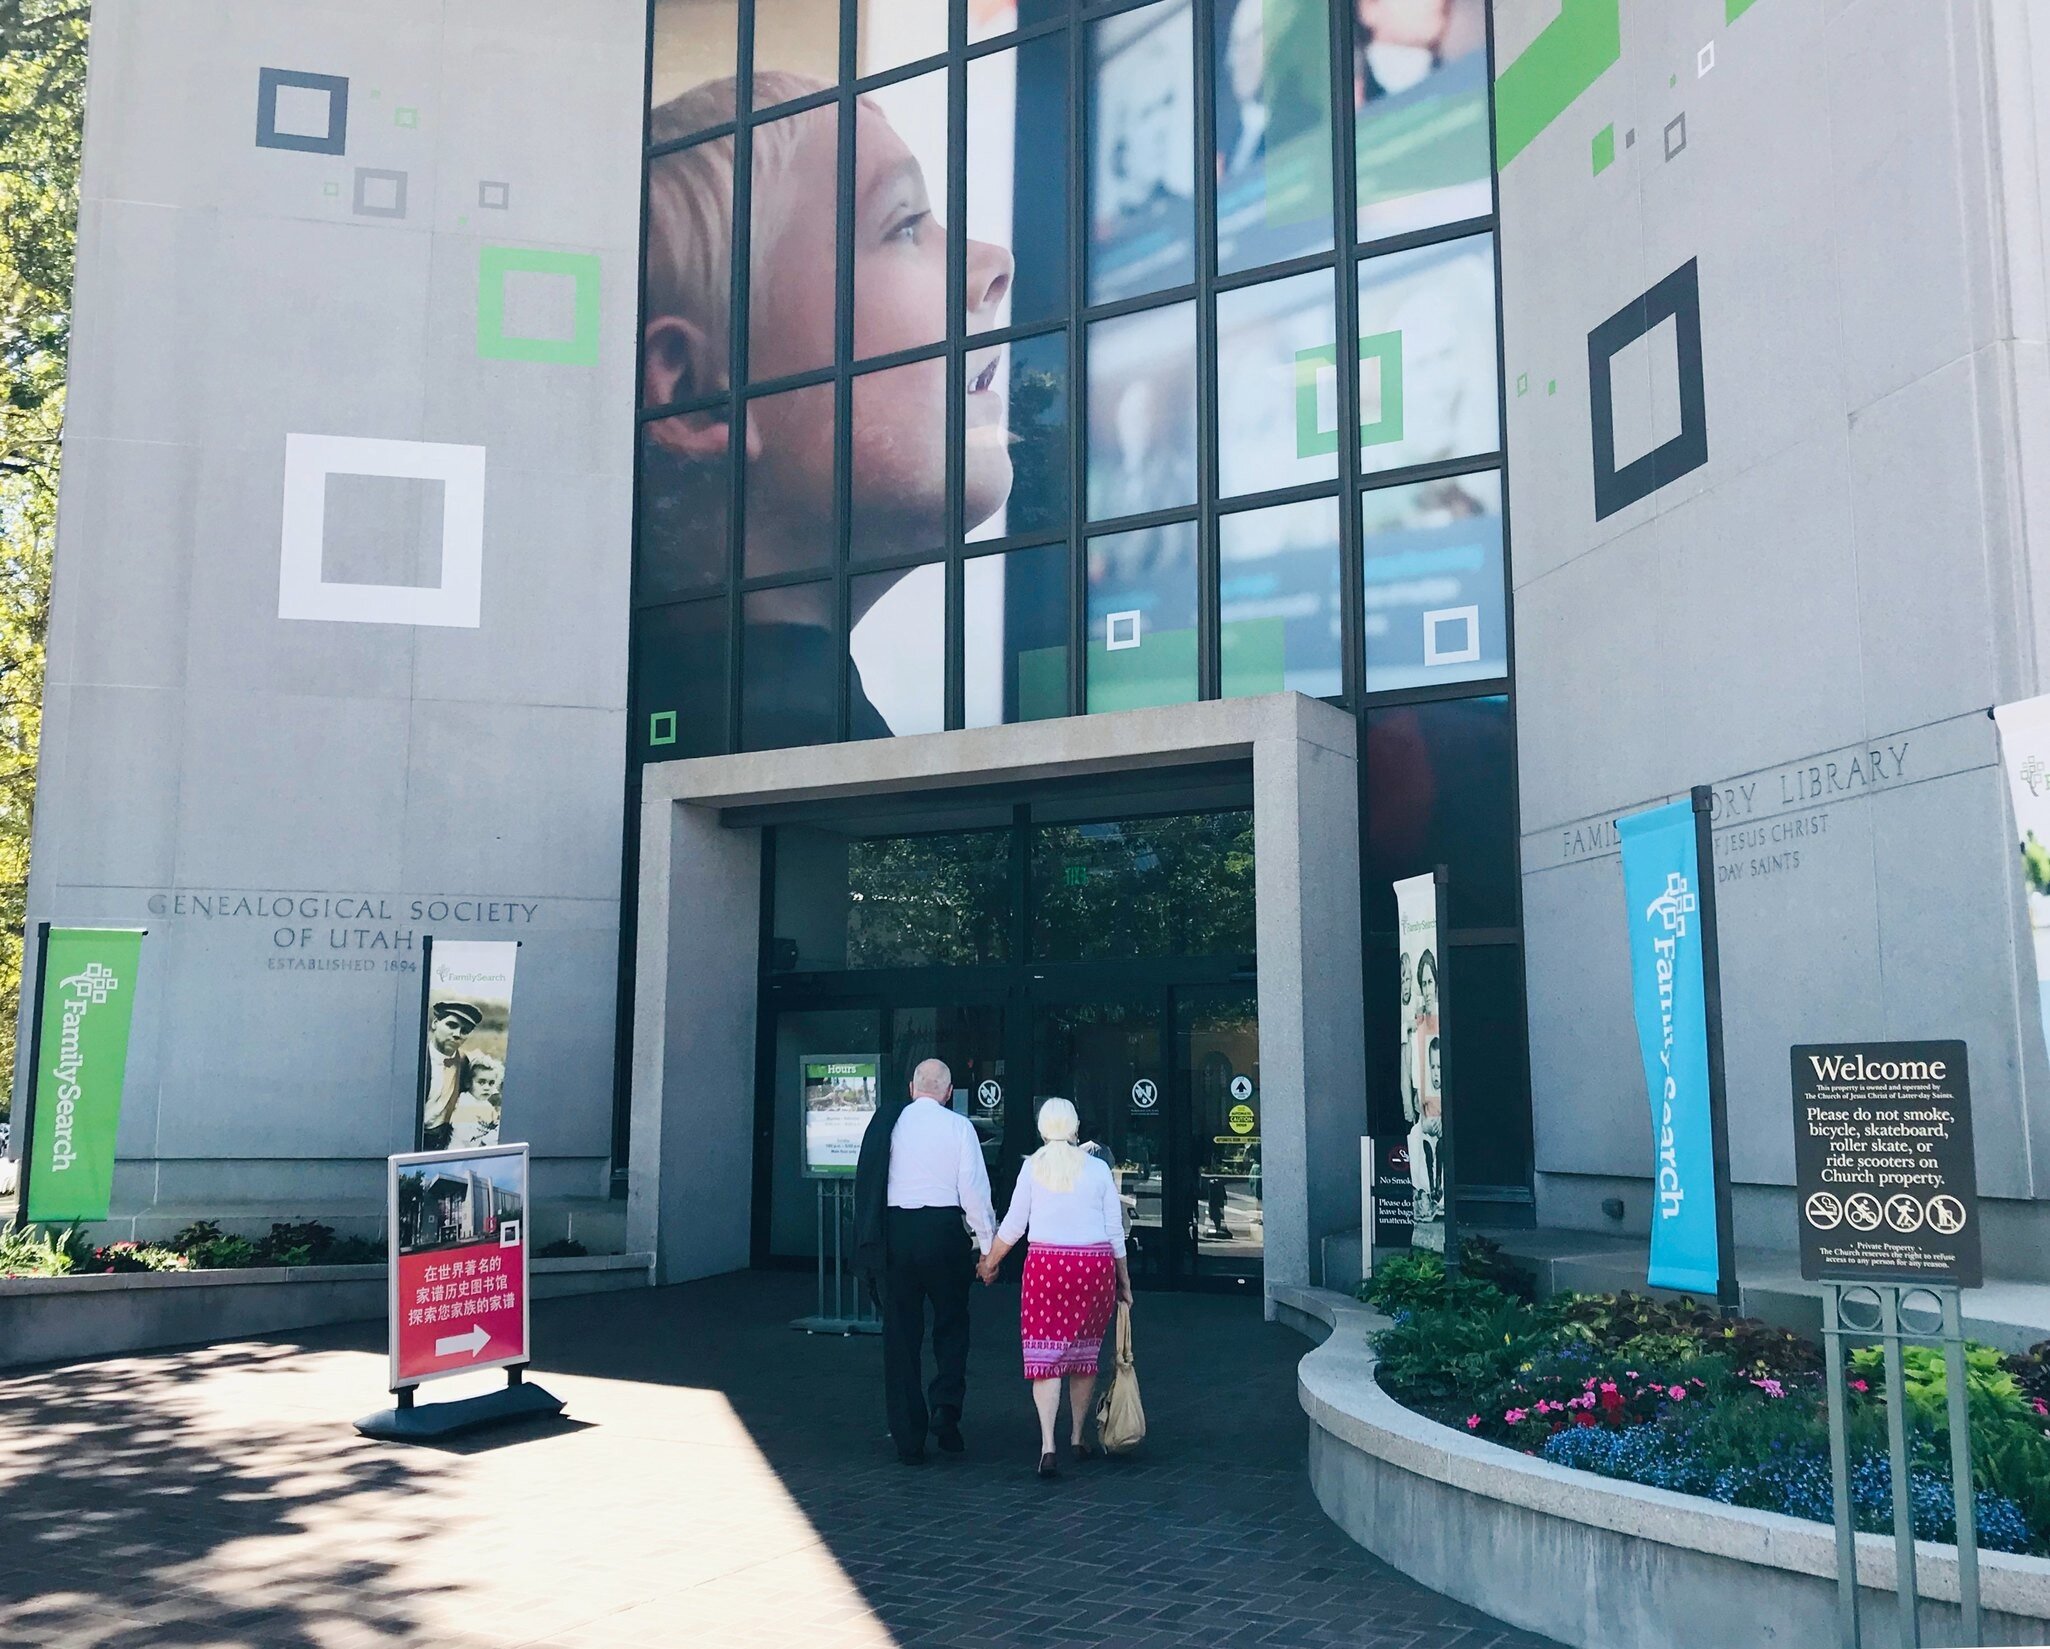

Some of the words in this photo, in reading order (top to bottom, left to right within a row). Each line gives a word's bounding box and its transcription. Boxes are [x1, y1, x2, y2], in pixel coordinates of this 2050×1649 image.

[1563, 821, 1621, 856] FAMIL
[1780, 742, 1909, 805] LIBRARY
[1724, 828, 1766, 856] JESUS
[1771, 814, 1829, 842] CHRIST
[1750, 851, 1800, 877] SAINTS
[147, 894, 392, 920] GENEALOGICAL
[410, 900, 538, 924] SOCIETY
[273, 927, 313, 949] OF
[330, 928, 413, 951] UTAH
[267, 957, 375, 972] ESTABLISHED
[384, 959, 416, 973] 1894
[448, 973, 506, 983] FamilySearch
[828, 1064, 857, 1074] Hours
[1809, 1054, 1946, 1081] Welcome
[52, 999, 88, 1173] FamilySearch
[1902, 1084, 1931, 1092] operated
[1932, 1083, 1941, 1091] by
[1807, 1107, 1849, 1120] Please
[1853, 1108, 1871, 1120] do
[1876, 1110, 1899, 1120] not
[1904, 1107, 1955, 1123] smoke,
[1809, 1123, 1860, 1139] bicycle,
[1864, 1123, 1949, 1139] skateboard,
[1830, 1138, 1868, 1151] roller
[1871, 1138, 1912, 1154] skate,
[1917, 1142, 1933, 1152] or
[1826, 1154, 1854, 1167] ride
[1857, 1157, 1915, 1168] scooters
[1919, 1158, 1938, 1168] on
[1380, 1176, 1391, 1184] No
[1392, 1176, 1411, 1185] Smok
[1821, 1169, 1874, 1182] Church
[1879, 1172, 1945, 1188] property.
[1379, 1199, 1400, 1207] Please
[1401, 1199, 1411, 1207] do
[1379, 1207, 1396, 1215] leave
[1397, 1207, 1413, 1217] bags
[1379, 1217, 1414, 1225] unattende
[1834, 1248, 1860, 1256] Church
[1904, 1252, 1921, 1260] right
[1933, 1253, 1955, 1261] refuse
[1857, 1242, 1882, 1250] Private
[1884, 1243, 1915, 1252] Property
[424, 1255, 502, 1283] 在世界著名的
[416, 1274, 508, 1305] 家谱历史图书馆
[408, 1292, 515, 1327] 探索您家族的家谱
